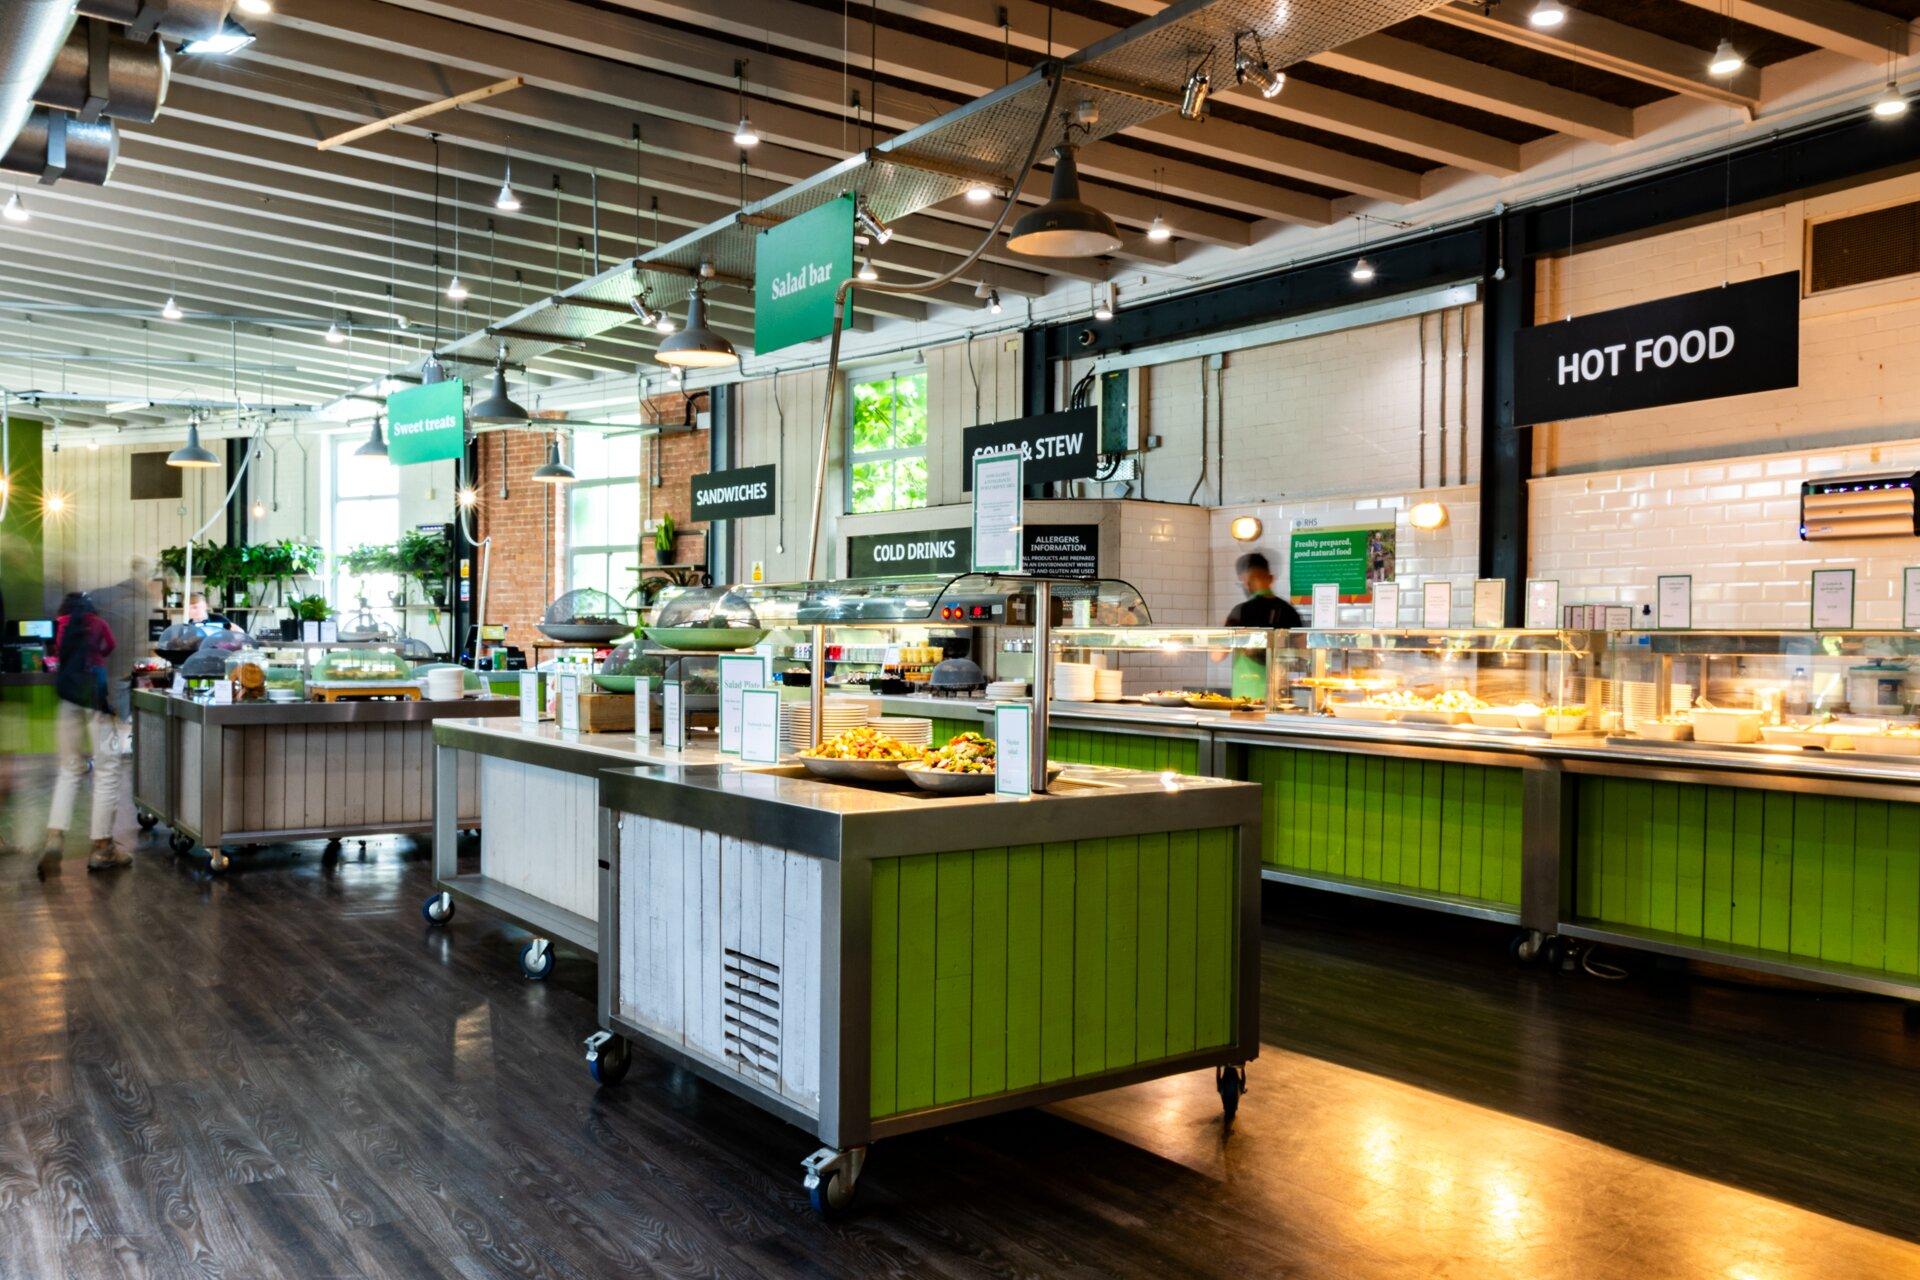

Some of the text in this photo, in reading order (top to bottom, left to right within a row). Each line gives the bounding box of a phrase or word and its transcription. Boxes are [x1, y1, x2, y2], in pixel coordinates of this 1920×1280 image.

[772, 263, 833, 300] Salad bar
[1558, 325, 1735, 386] HOT FOOD
[394, 415, 456, 436] Sweet treats
[1020, 440, 1033, 462] &
[1035, 432, 1084, 460] STEW
[696, 482, 768, 506] SANDWICHES
[1304, 518, 1318, 527] RHS
[873, 540, 956, 562] COLD DRINKS
[1030, 544, 1087, 552] INFORMATION
[1294, 537, 1352, 549] Freshly prepared,
[1294, 547, 1352, 559] good natural food
[724, 680, 743, 689] Salad
